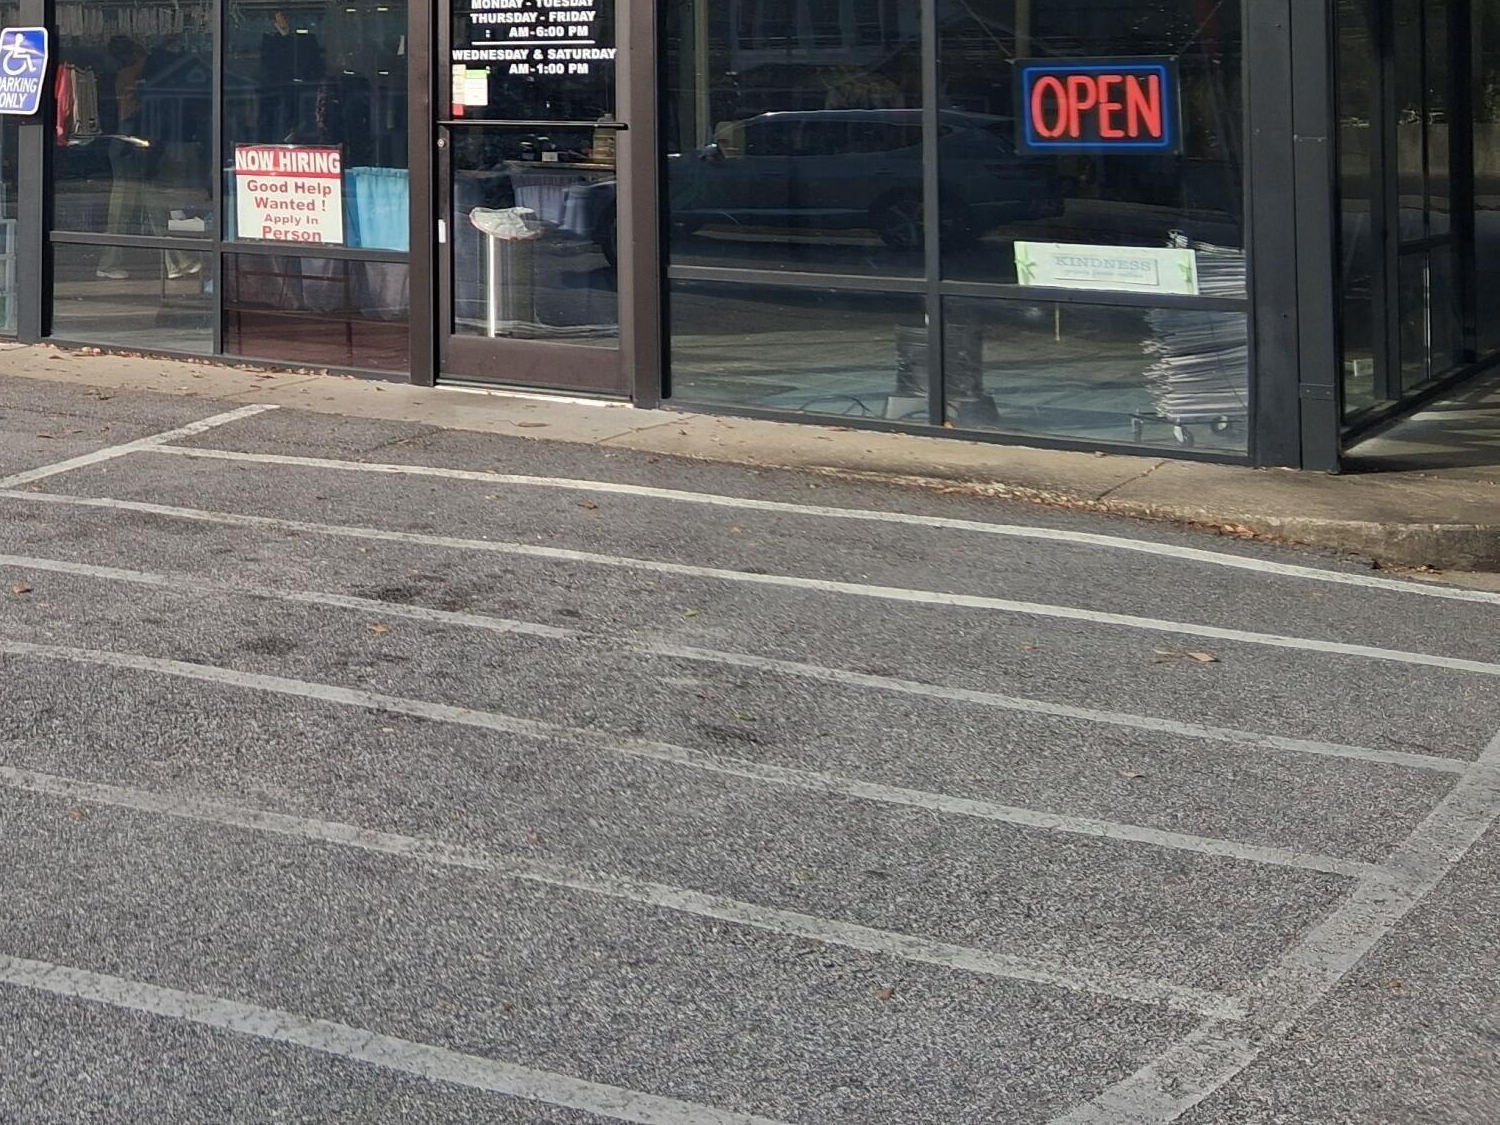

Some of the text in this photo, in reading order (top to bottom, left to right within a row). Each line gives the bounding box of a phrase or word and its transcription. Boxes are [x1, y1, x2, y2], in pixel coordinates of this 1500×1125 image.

[470, 12, 538, 24] THURSDAY
[549, 11, 596, 23] FRIDAY
[568, 25, 589, 37] PM
[452, 48, 617, 61] WEDNESDAY & SATURDAY
[568, 63, 589, 74] PM
[1031, 75, 1162, 138] OPEN
[235, 150, 340, 174] NOW HIRING
[247, 179, 332, 197] Good Help
[254, 196, 315, 211] Wanted
[264, 213, 318, 226] Apply In
[262, 225, 322, 241] Person
[1055, 256, 1151, 272] KINDNESS
